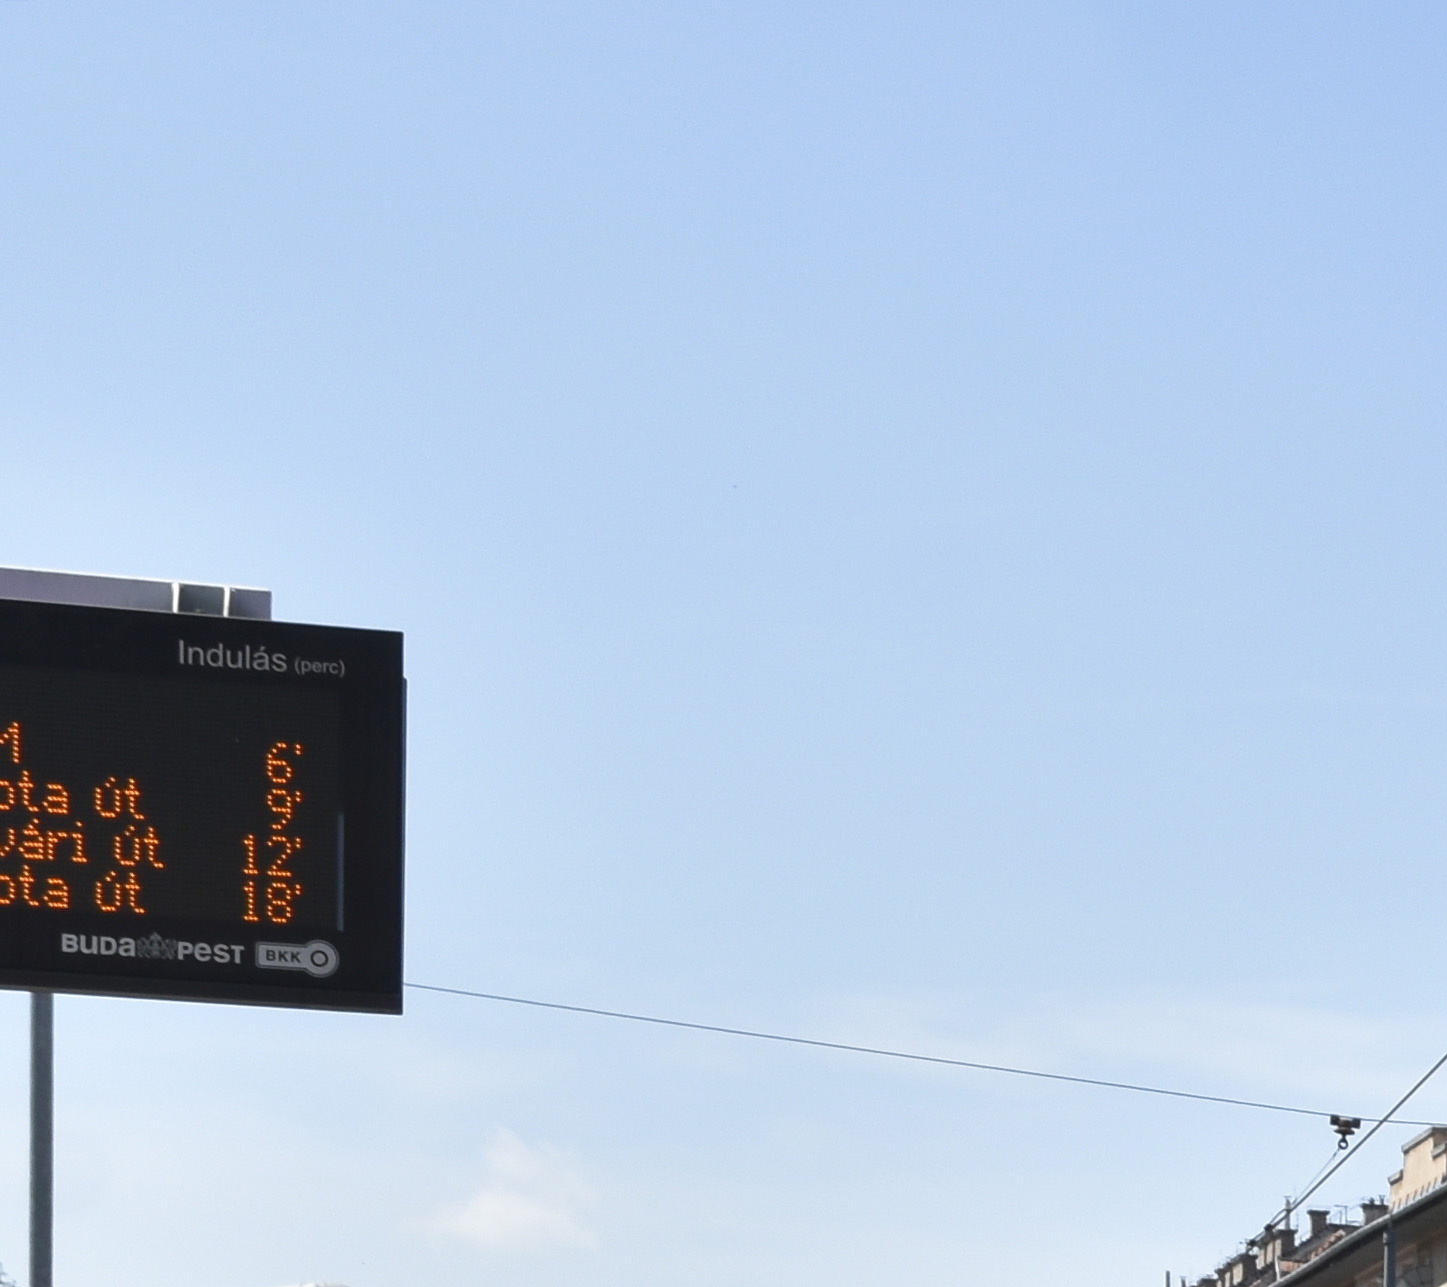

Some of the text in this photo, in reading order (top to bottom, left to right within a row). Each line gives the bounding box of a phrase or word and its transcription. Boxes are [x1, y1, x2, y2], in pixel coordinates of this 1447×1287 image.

[178, 639, 346, 678] Indulás (perc)
[95, 776, 146, 820] út
[114, 824, 165, 870] út
[95, 870, 146, 914] út
[265, 949, 302, 964] BKK
